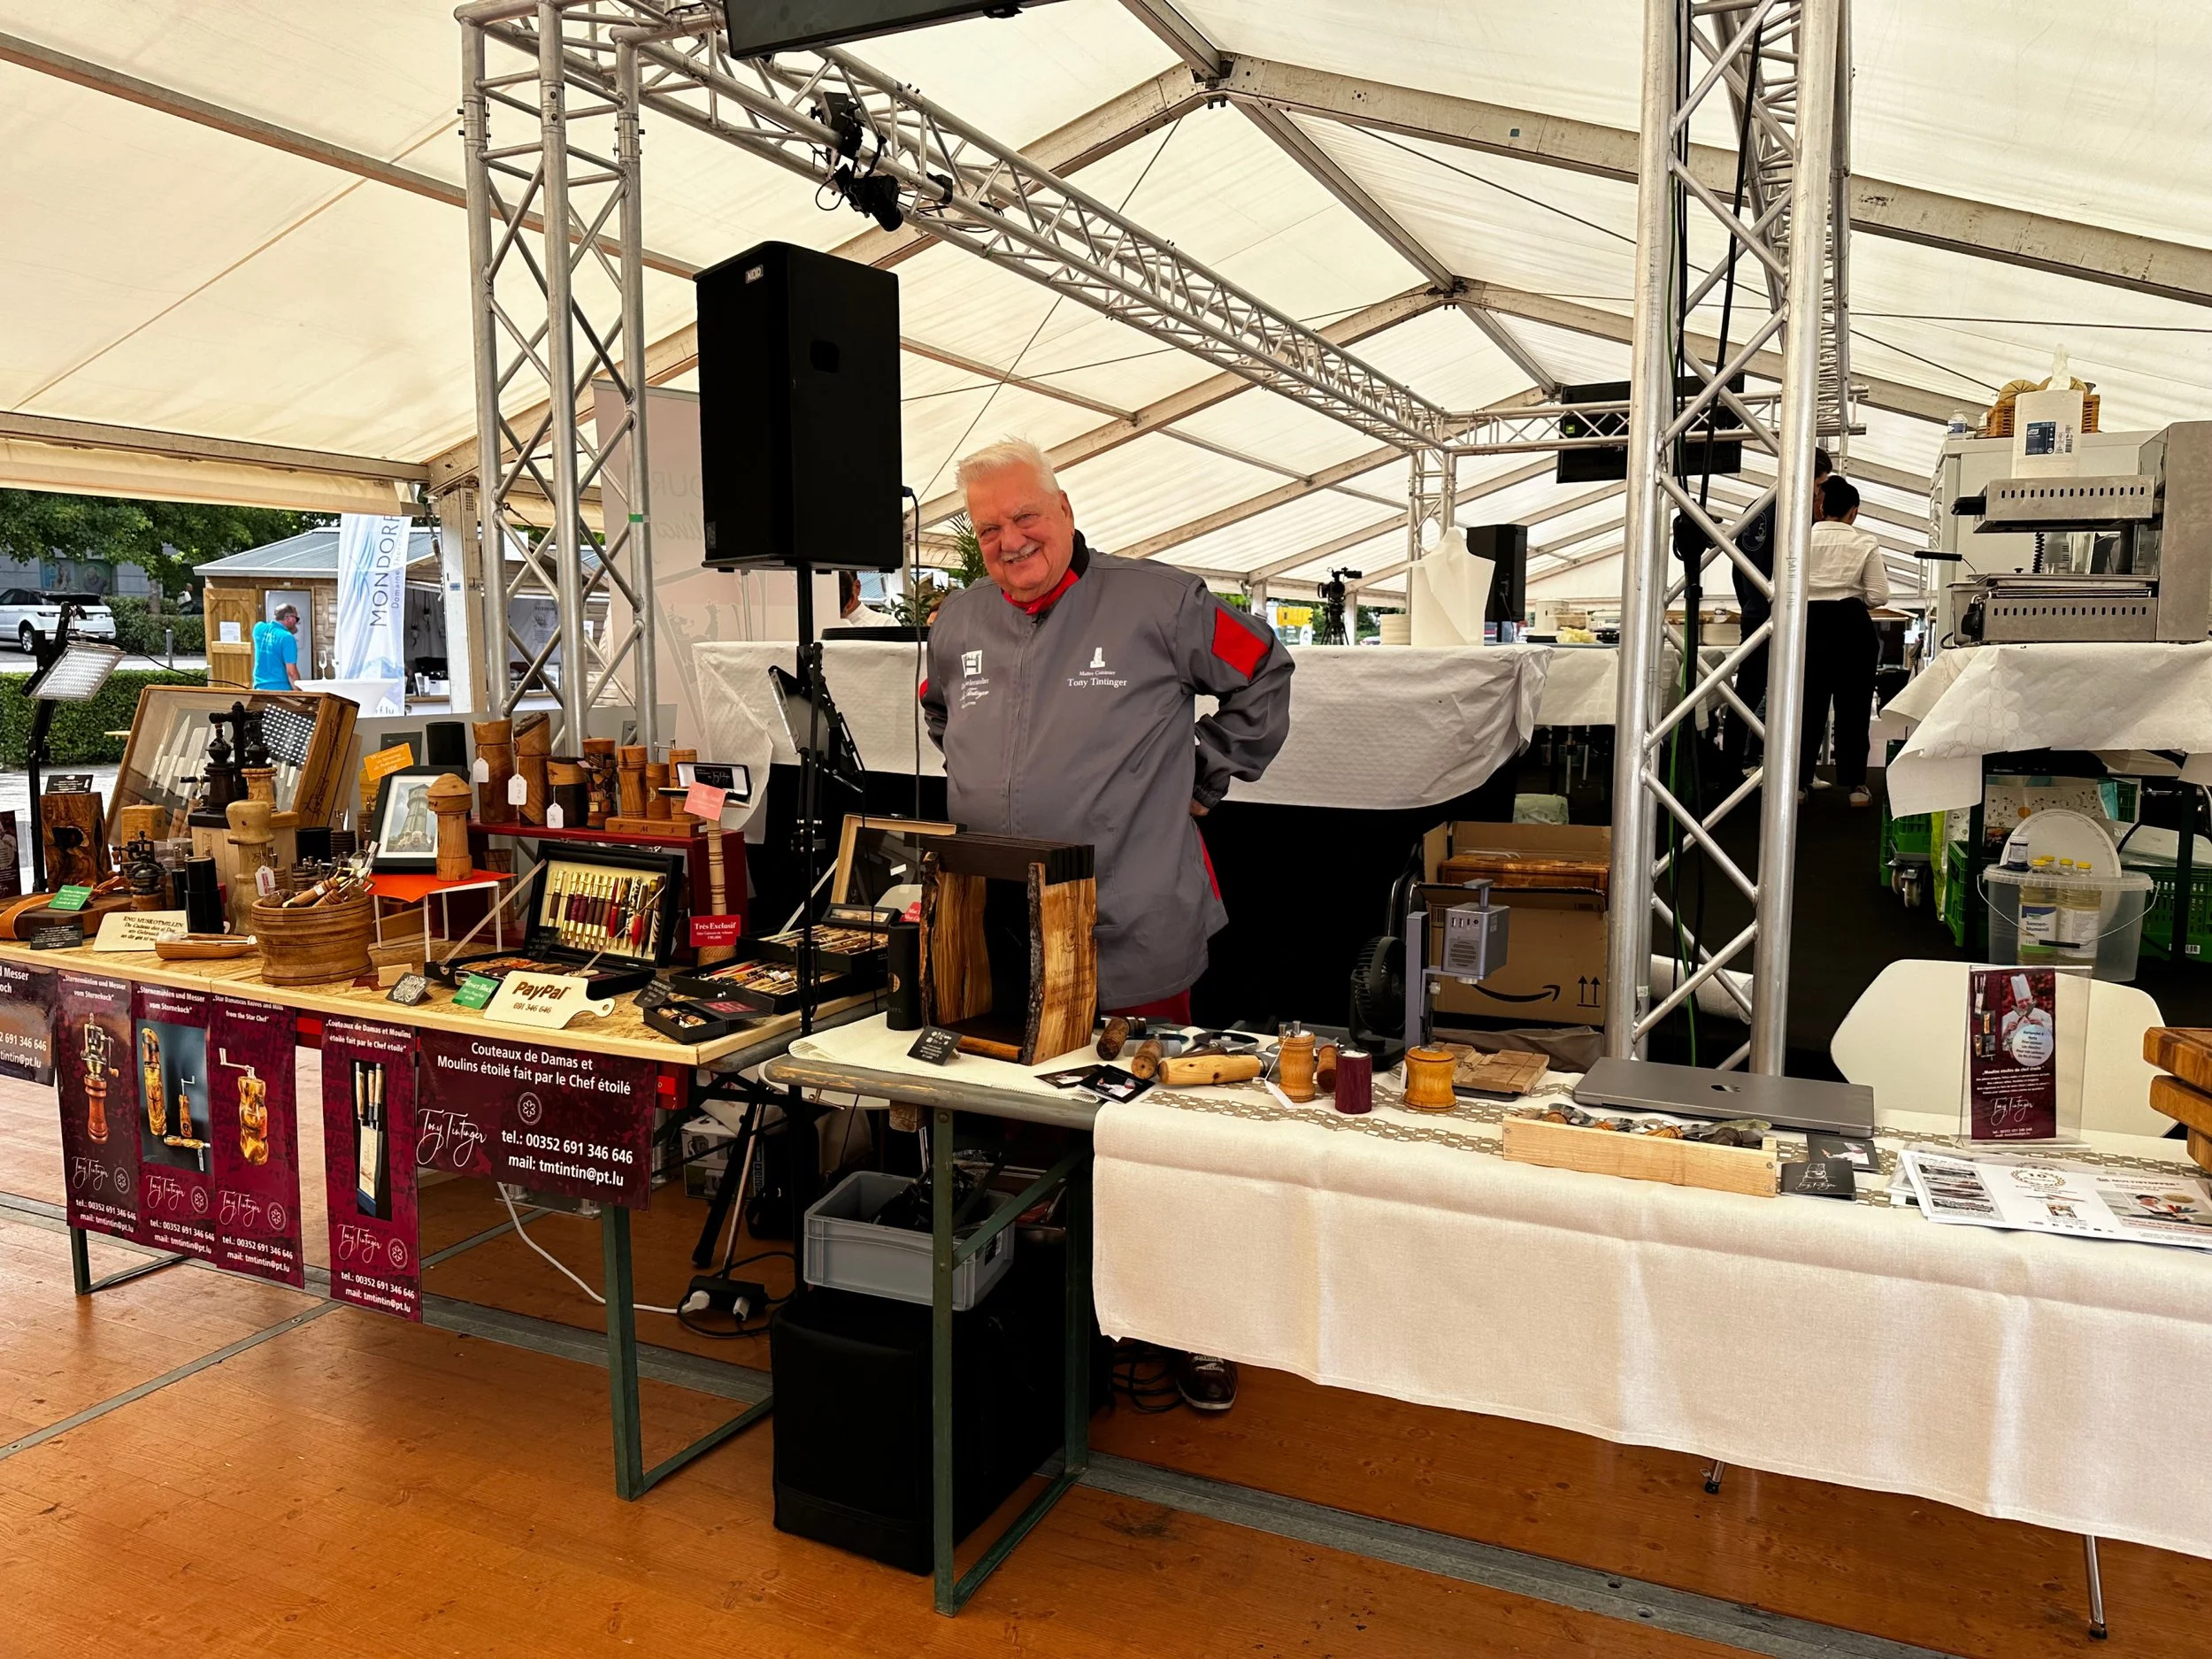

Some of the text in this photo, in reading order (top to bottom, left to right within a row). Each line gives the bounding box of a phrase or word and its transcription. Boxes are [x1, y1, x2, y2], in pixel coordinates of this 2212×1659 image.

[391, 571, 401, 609] Domaine
[1067, 677, 1127, 688] Tony Tintinger
[4, 967, 29, 981] Messer
[109, 980, 127, 990] Messer
[512, 981, 569, 1000] PayPal
[175, 991, 186, 1000] und
[187, 993, 205, 1003] Messer
[224, 996, 247, 1006] Damascus
[247, 999, 263, 1008] Knives
[226, 1010, 237, 1018] from
[363, 1025, 381, 1034] Damas
[388, 1028, 411, 1039] Moulins
[5, 1033, 18, 1045] 691
[19, 1036, 32, 1048] 346
[34, 1039, 47, 1052] 646
[346, 1036, 356, 1045] fait
[357, 1039, 366, 1048] par
[366, 1039, 373, 1048] le
[373, 1041, 387, 1049] Chef
[471, 1042, 594, 1071] Couteaux de Damas et
[437, 1055, 631, 1095] Moulins étoilé fait par le Chef étoilé
[416, 1109, 488, 1168] Tony Tintinger
[502, 1130, 634, 1164] tel.: 00352 691 346 646
[508, 1154, 625, 1187] mail: tmtintin@pt.lu
[80, 1213, 95, 1223] mail:
[88, 1201, 104, 1212] 00352
[105, 1206, 116, 1215] 691
[117, 1209, 127, 1217] 346
[127, 1211, 137, 1221] 646
[150, 1218, 215, 1242] tel.: 00352 691 346 646
[154, 1233, 170, 1244] mail:
[222, 1236, 294, 1260] tel.: 00352 691 346 646
[227, 1251, 290, 1272] mail: tmtintin@pt.lu
[341, 1271, 415, 1299] tel.: 00352 691 346 646
[345, 1287, 411, 1313] mail: tmtintin@pt.lu
